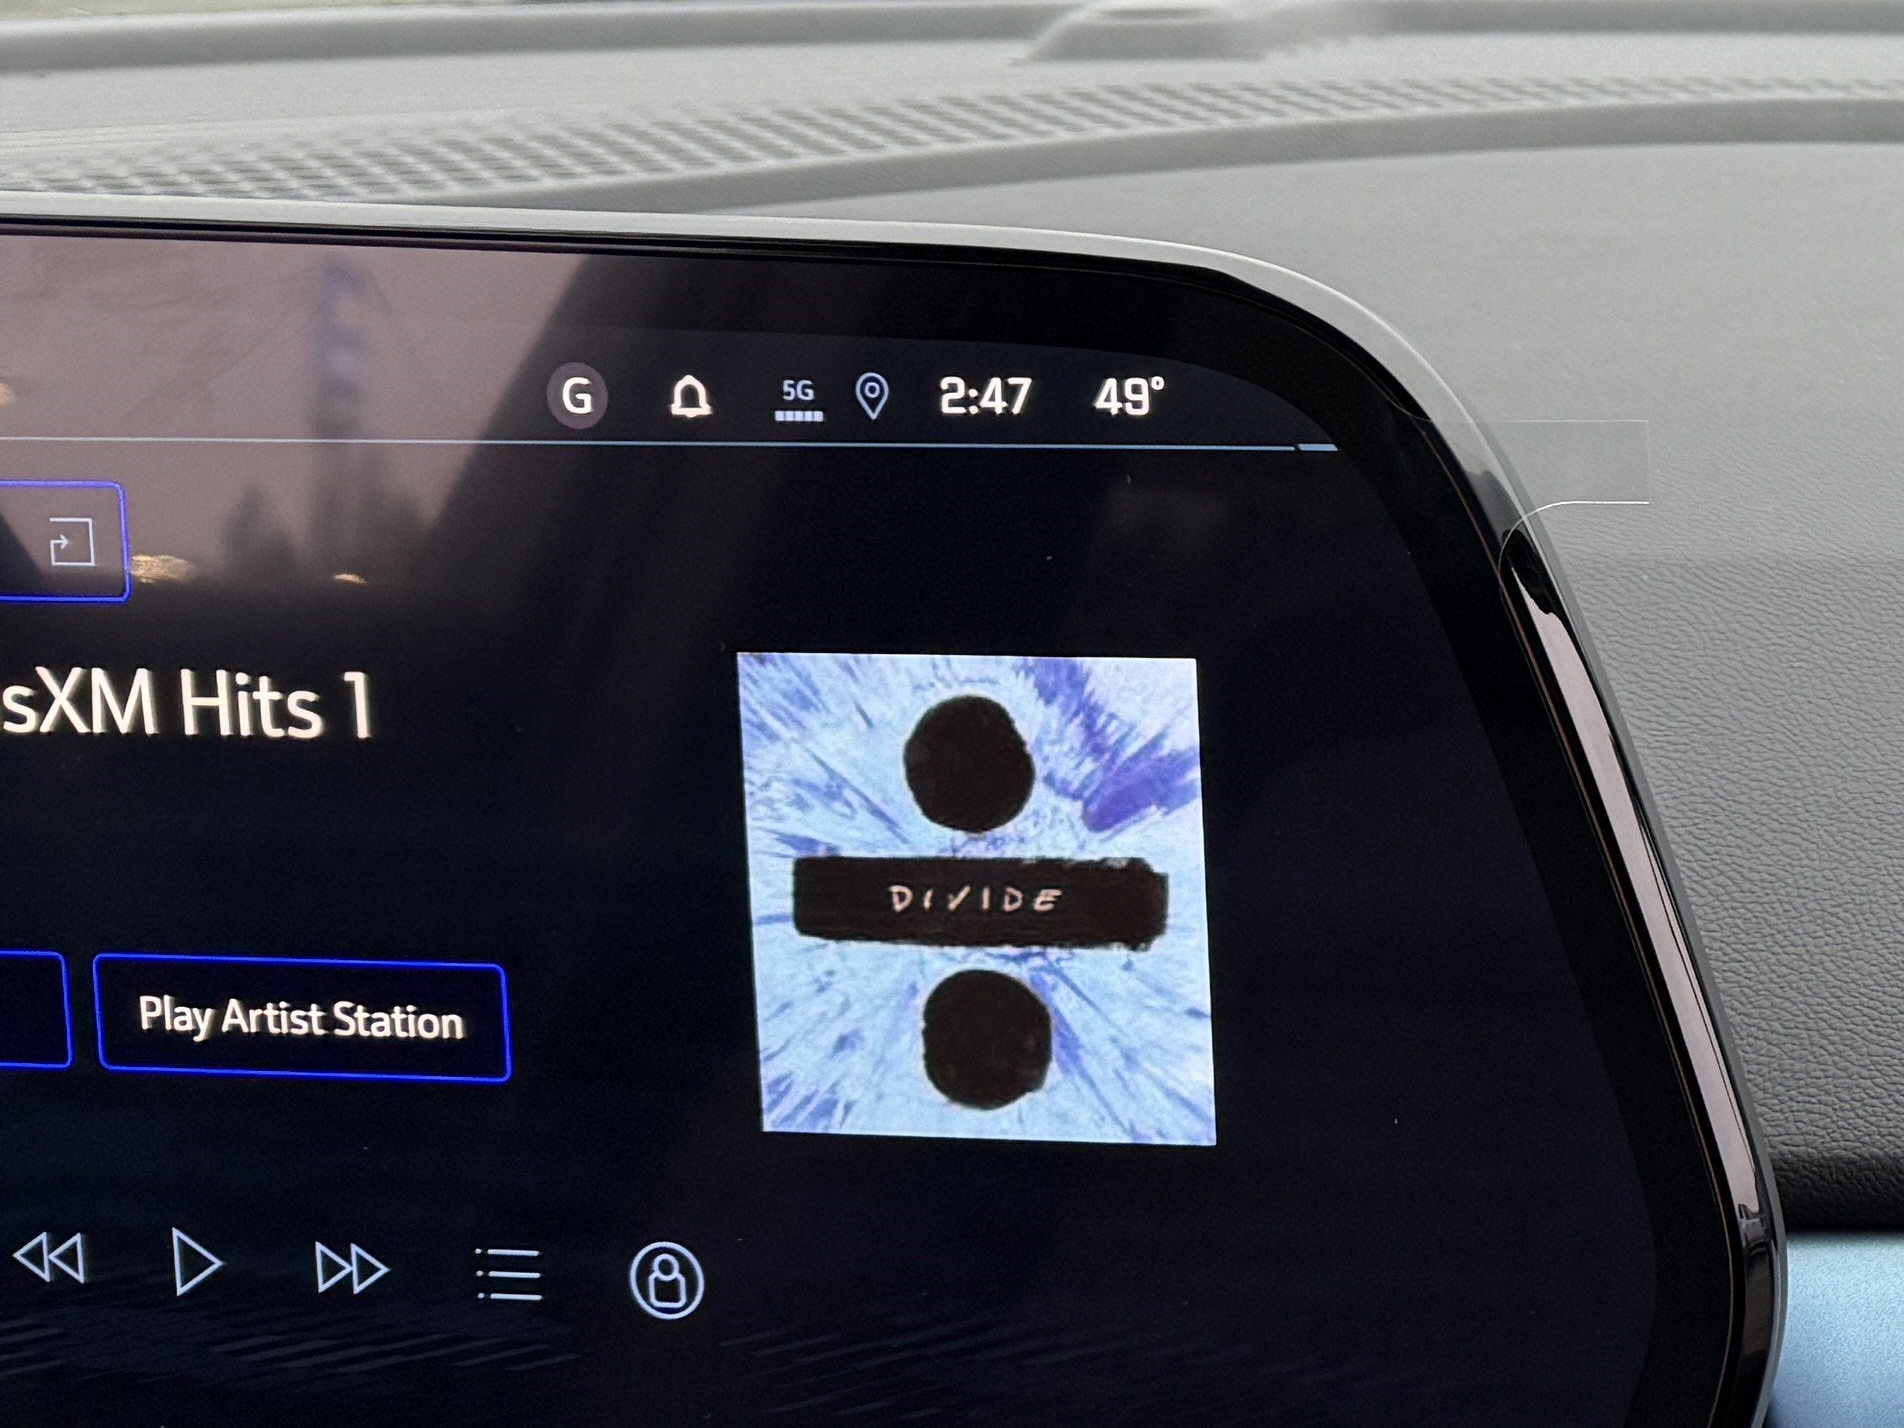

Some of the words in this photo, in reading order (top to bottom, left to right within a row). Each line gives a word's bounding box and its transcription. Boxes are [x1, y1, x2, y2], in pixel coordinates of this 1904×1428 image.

[561, 375, 594, 417] G
[781, 379, 815, 402] 5G
[940, 376, 1033, 416] 2:47
[180, 668, 324, 739] Hits
[343, 670, 371, 739] 1
[888, 883, 1064, 913] DIVIDE
[139, 994, 213, 1043] Play
[222, 998, 327, 1035] Artist
[333, 1000, 467, 1040] Station
